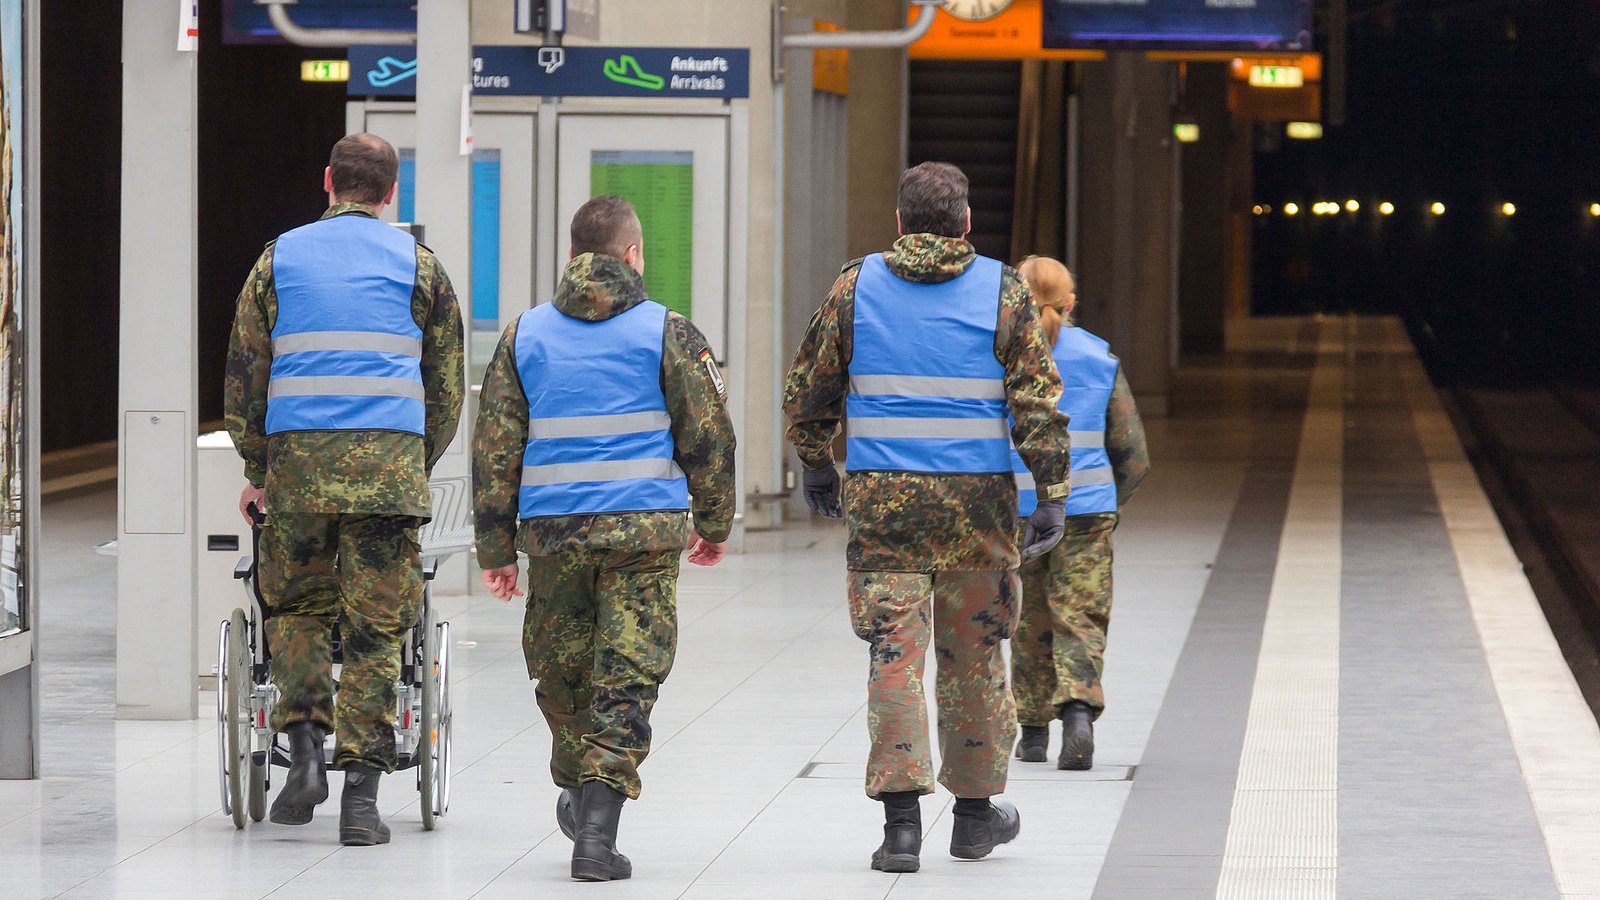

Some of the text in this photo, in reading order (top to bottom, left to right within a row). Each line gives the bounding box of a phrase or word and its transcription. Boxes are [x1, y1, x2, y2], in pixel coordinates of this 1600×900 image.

[671, 56, 728, 72] Ankunft
[473, 74, 510, 88] tures
[671, 74, 725, 90] Arrivals
